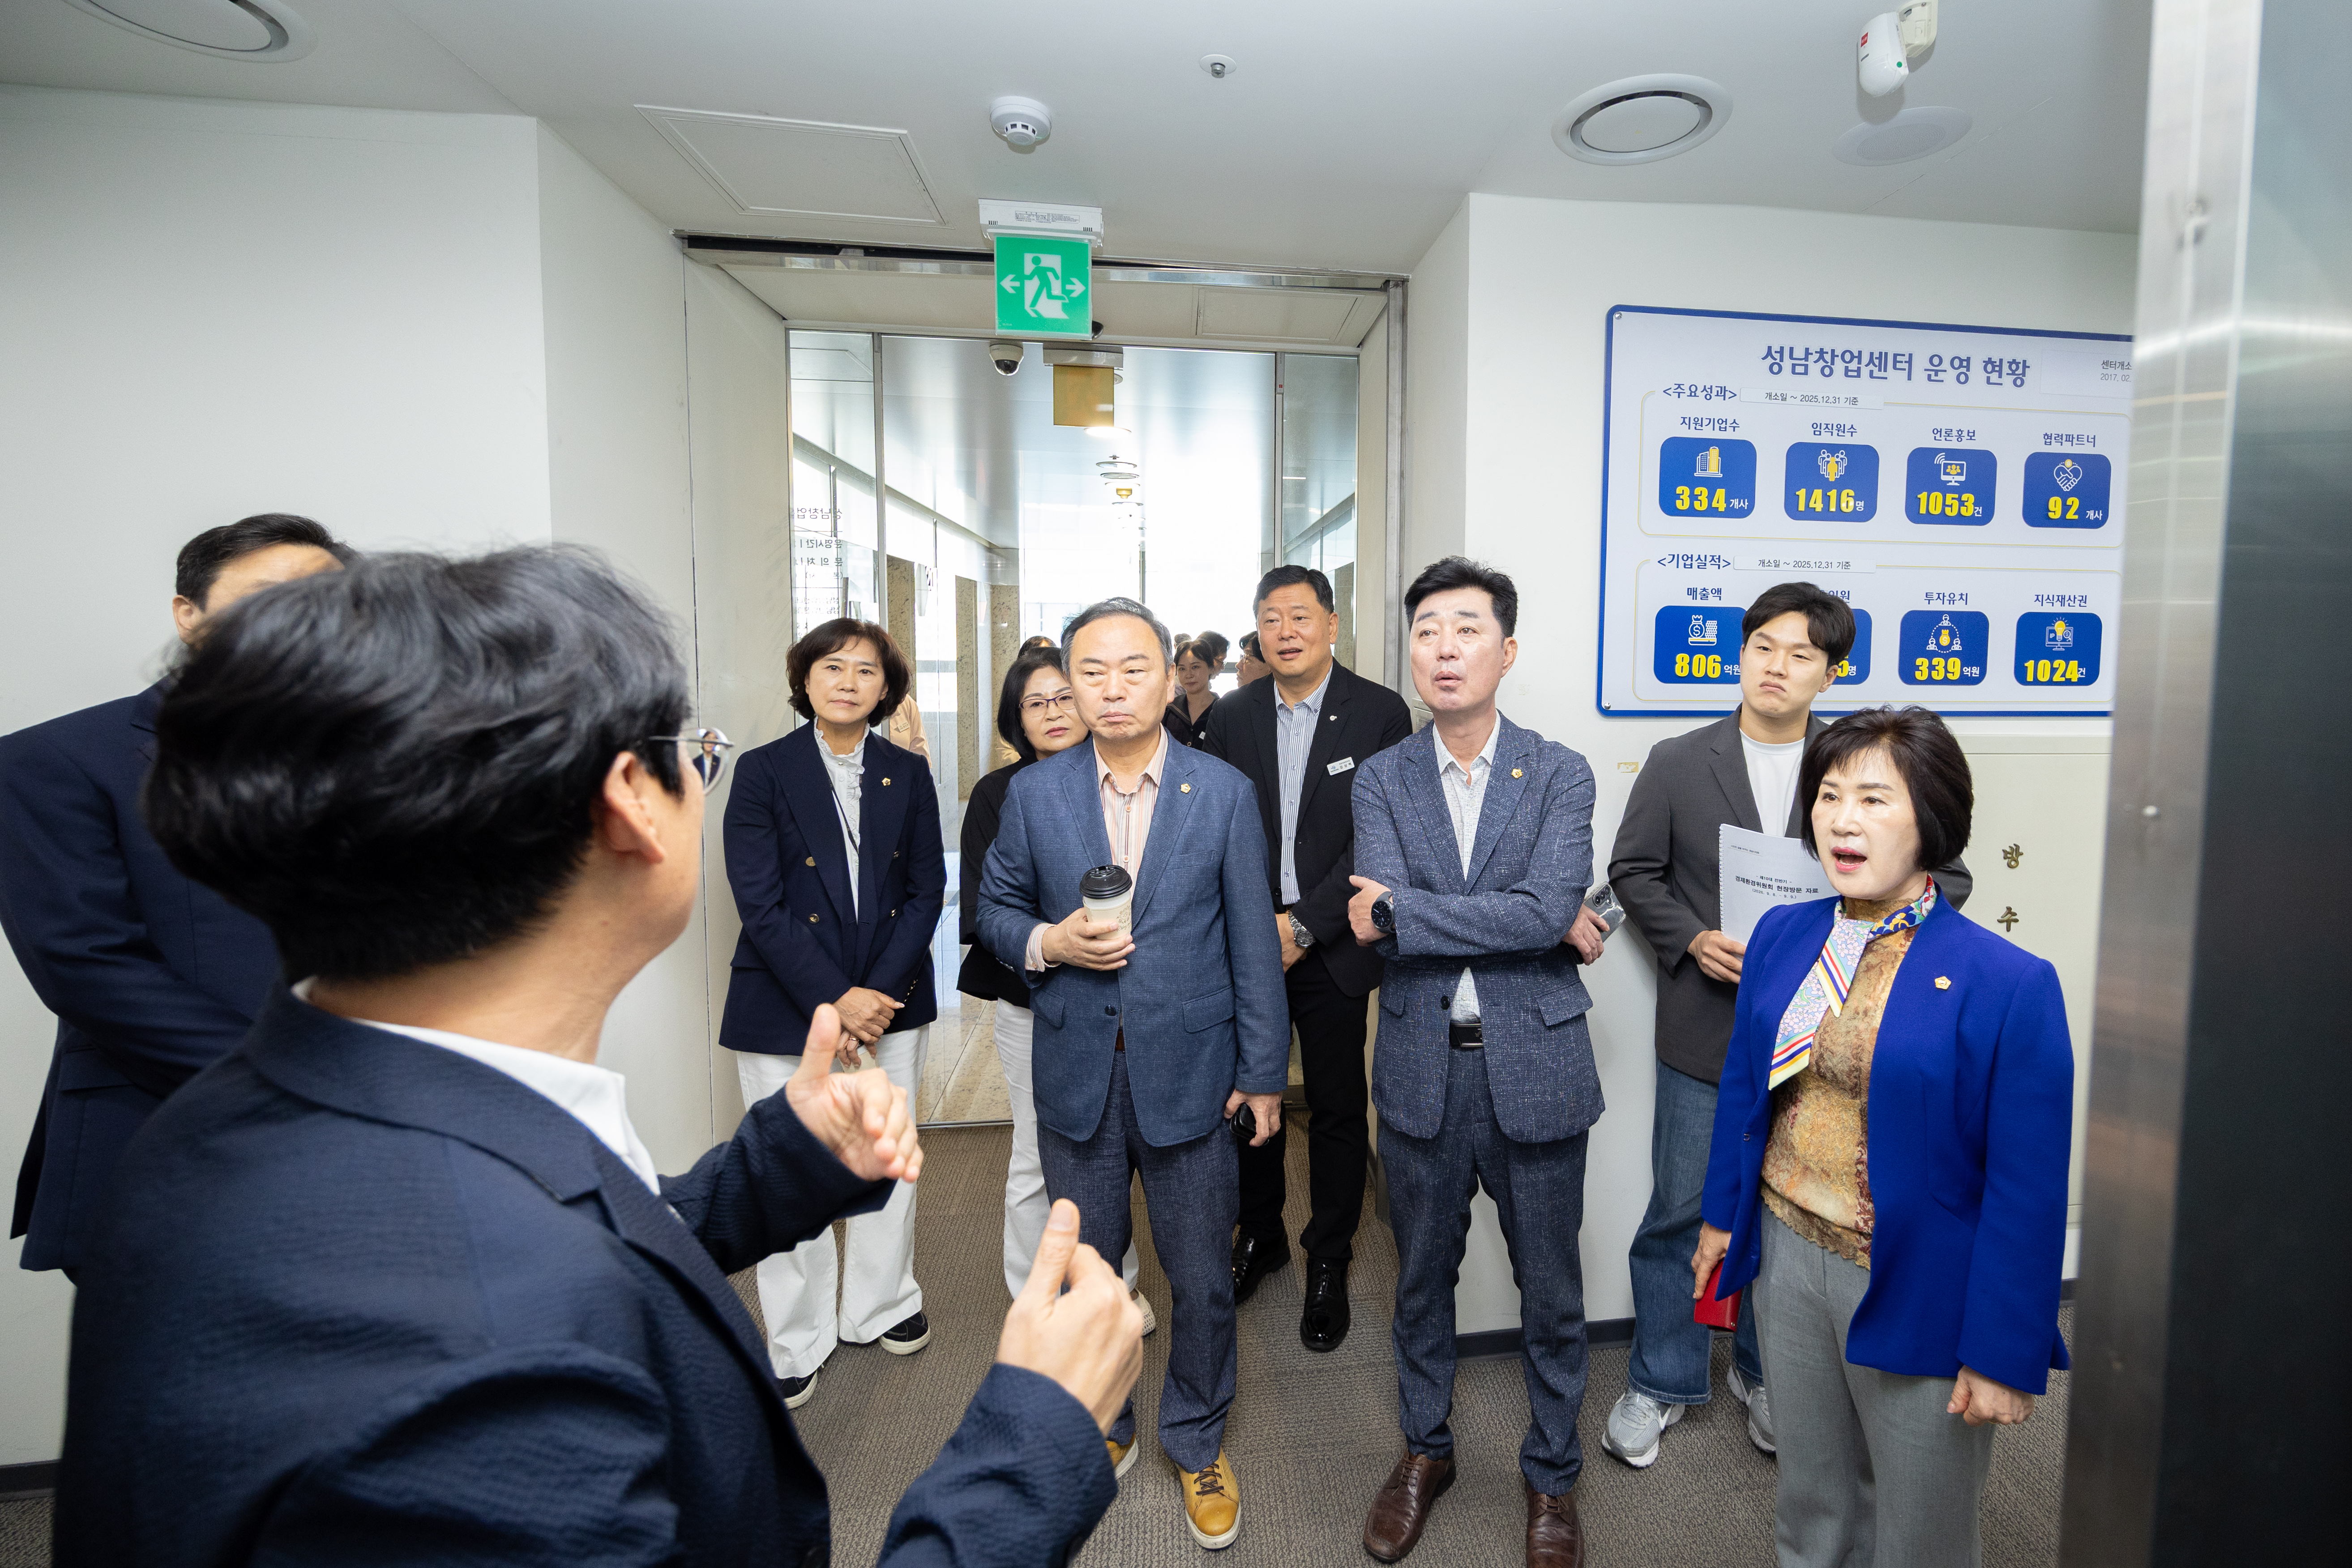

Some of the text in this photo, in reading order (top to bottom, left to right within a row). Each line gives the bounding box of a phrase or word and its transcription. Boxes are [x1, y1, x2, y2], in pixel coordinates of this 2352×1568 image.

[1761, 345, 2031, 388] 성남창업센터 운영 현황
[2101, 360, 2132, 371] 센터개소
[2100, 373, 2119, 382] 2017.
[1663, 383, 1737, 401] <주요성과>
[1765, 391, 1788, 402] 개소일
[1800, 393, 1841, 405] 2025.12.31
[1843, 396, 1859, 406] 기준
[1680, 416, 1740, 432] 지원기업수
[1811, 422, 1858, 437] 임직원수
[1931, 427, 1976, 442] 언론홍보
[2042, 432, 2097, 448] 협력파트너
[1657, 553, 1732, 570] <기업실적>
[1758, 559, 1781, 568] 개소일
[1792, 560, 1834, 569] 2025.12.31
[1836, 560, 1852, 570] 기준
[1686, 587, 1723, 601] 매출액
[1924, 592, 1969, 606] 투자유치
[2033, 594, 2088, 607] 지식재산권
[1735, 875, 1773, 890] 경제환경위원회
[1776, 884, 1802, 894] 현장방문
